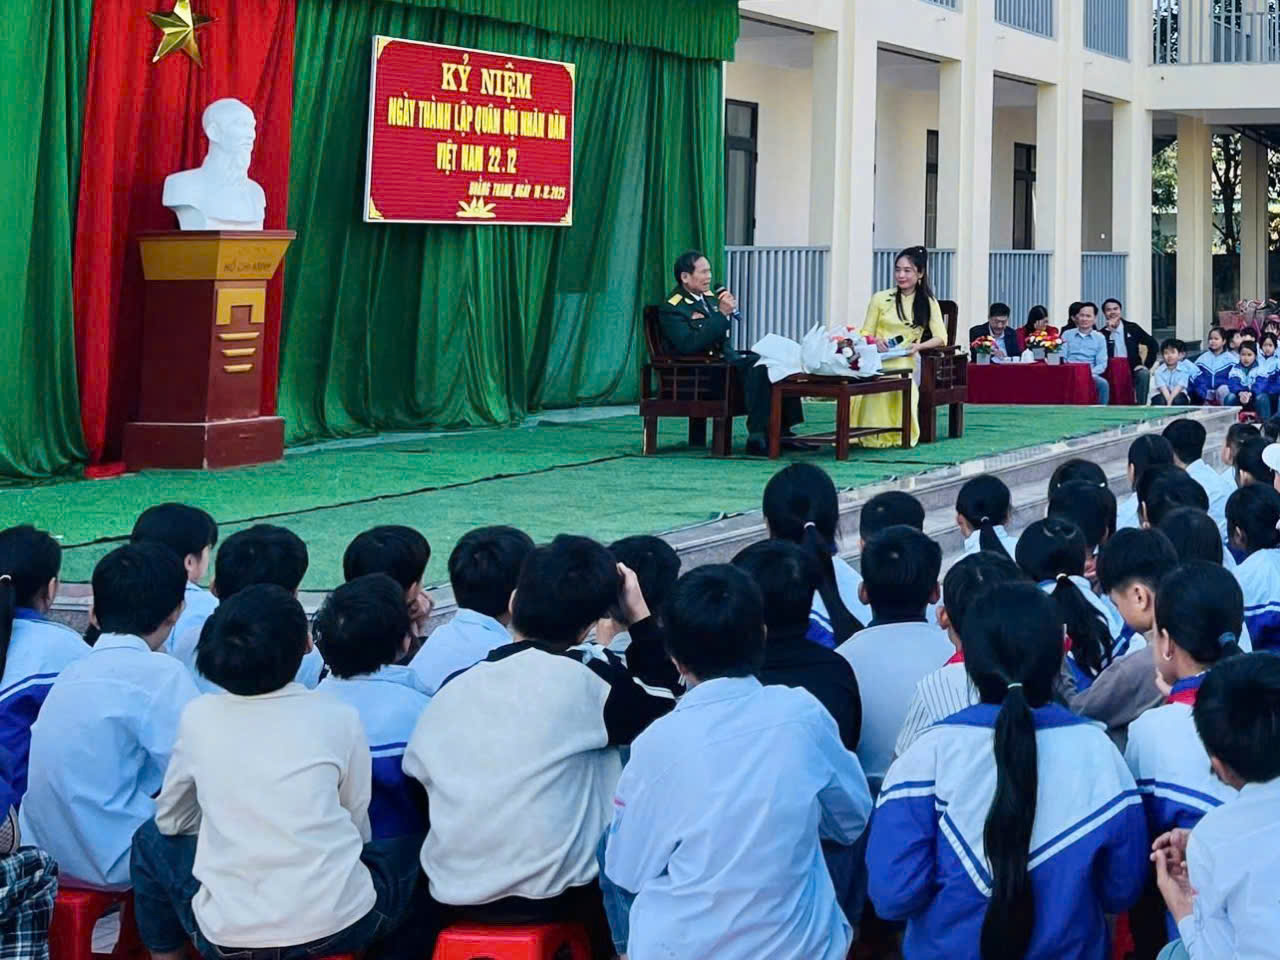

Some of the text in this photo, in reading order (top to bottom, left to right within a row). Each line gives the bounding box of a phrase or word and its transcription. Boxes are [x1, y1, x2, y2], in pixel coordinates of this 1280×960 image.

[441, 53, 533, 103] KỶ NIỆM
[388, 91, 416, 128] NGÀY
[454, 100, 474, 137] LẬP
[437, 138, 458, 175] VIỆT
